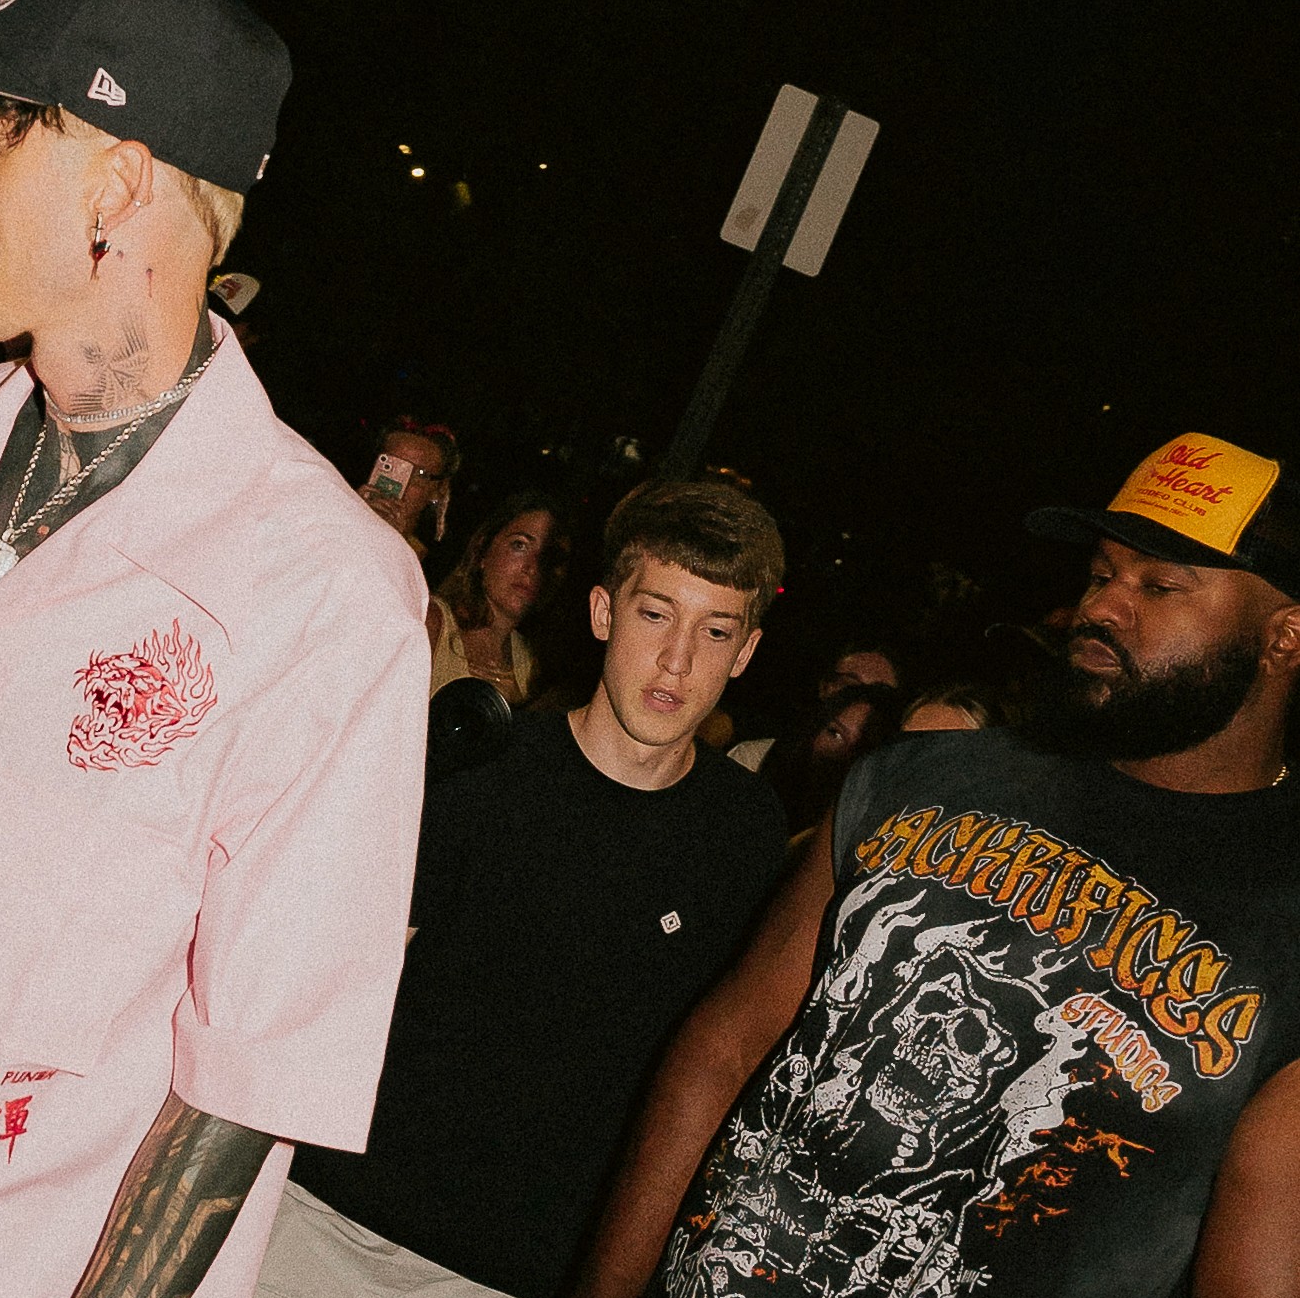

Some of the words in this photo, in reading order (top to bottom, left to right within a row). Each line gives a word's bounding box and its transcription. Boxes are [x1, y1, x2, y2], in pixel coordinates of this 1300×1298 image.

[1155, 468, 1234, 504] Heart
[1173, 498, 1207, 517] CLUB
[1060, 991, 1182, 1113] STUDIOS
